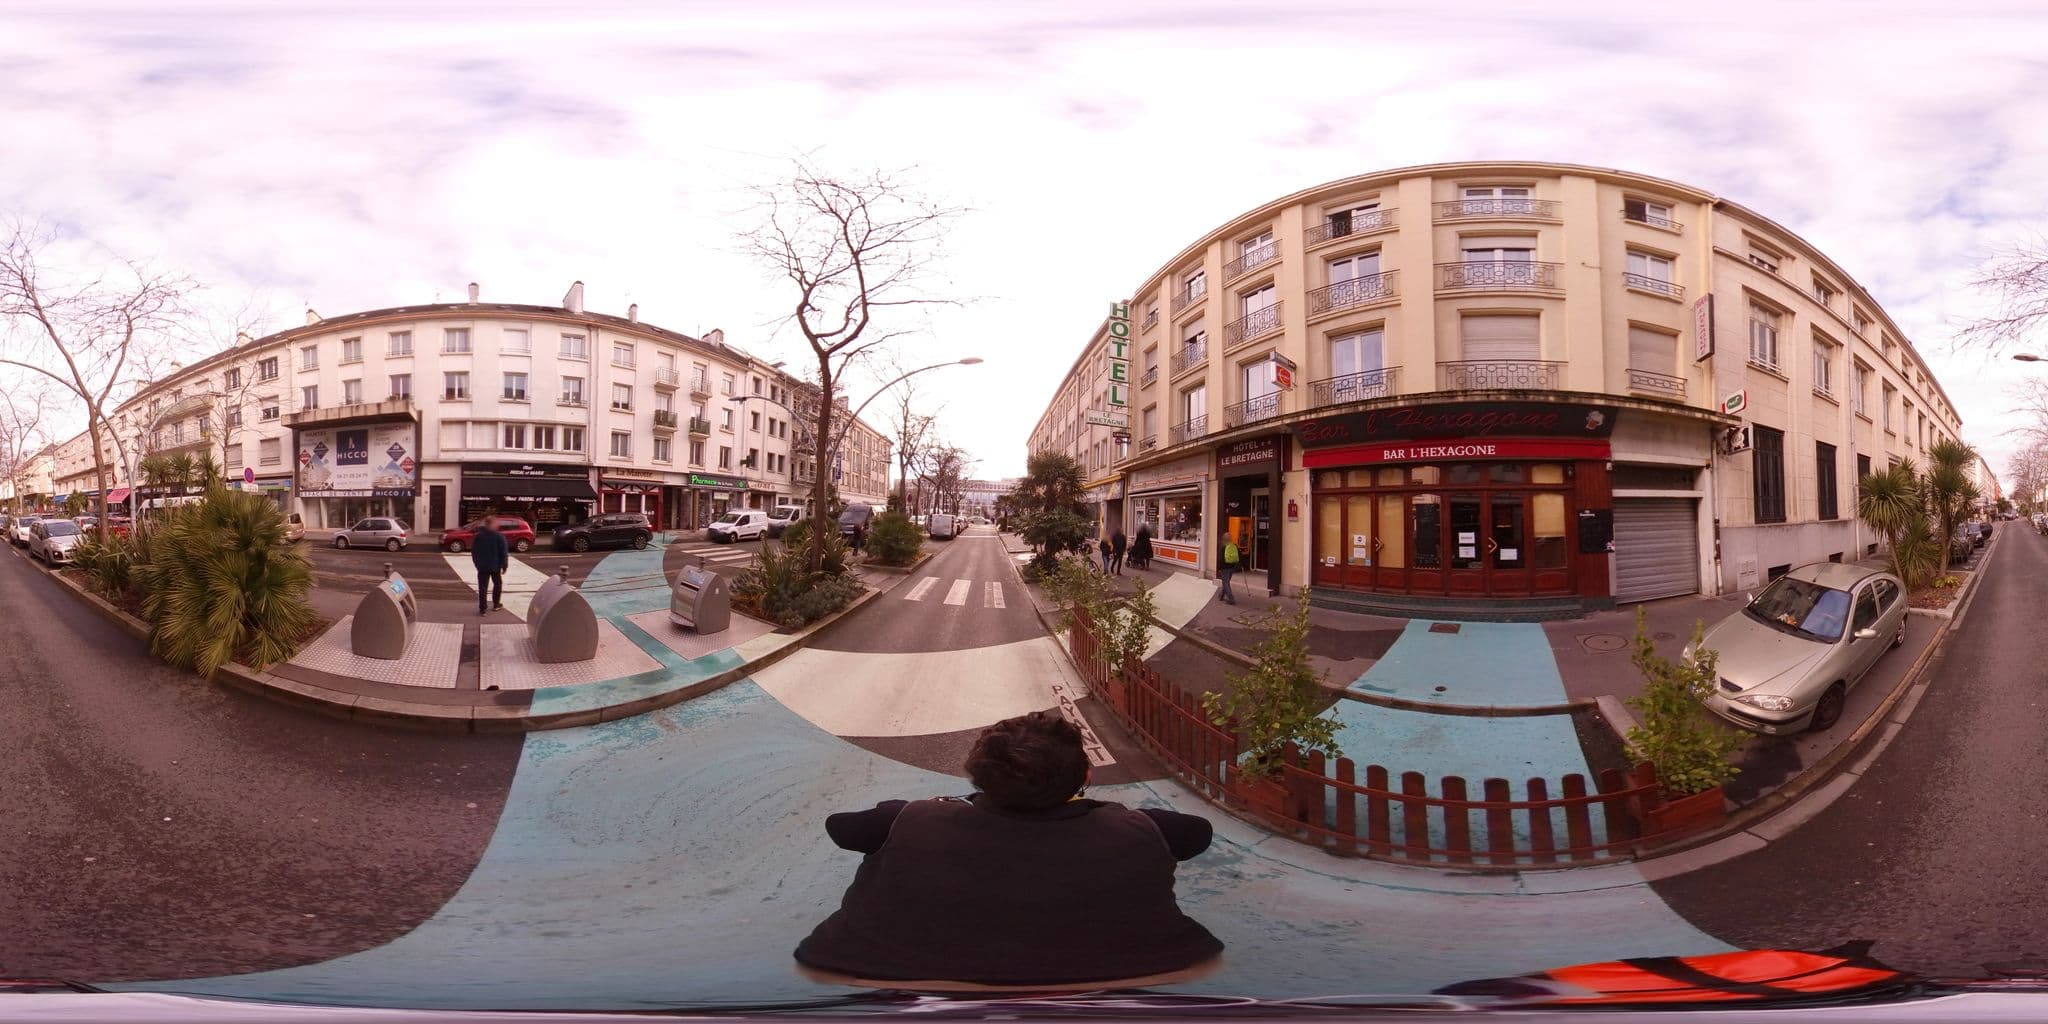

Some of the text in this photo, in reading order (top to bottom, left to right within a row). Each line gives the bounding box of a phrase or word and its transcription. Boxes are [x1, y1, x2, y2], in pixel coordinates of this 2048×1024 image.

[1111, 303, 1129, 405] HOTEL
[337, 450, 368, 460] HICCO
[1221, 448, 1273, 466] LE BRETAGNE
[1383, 445, 1496, 460] BAR L'HEXAGONE
